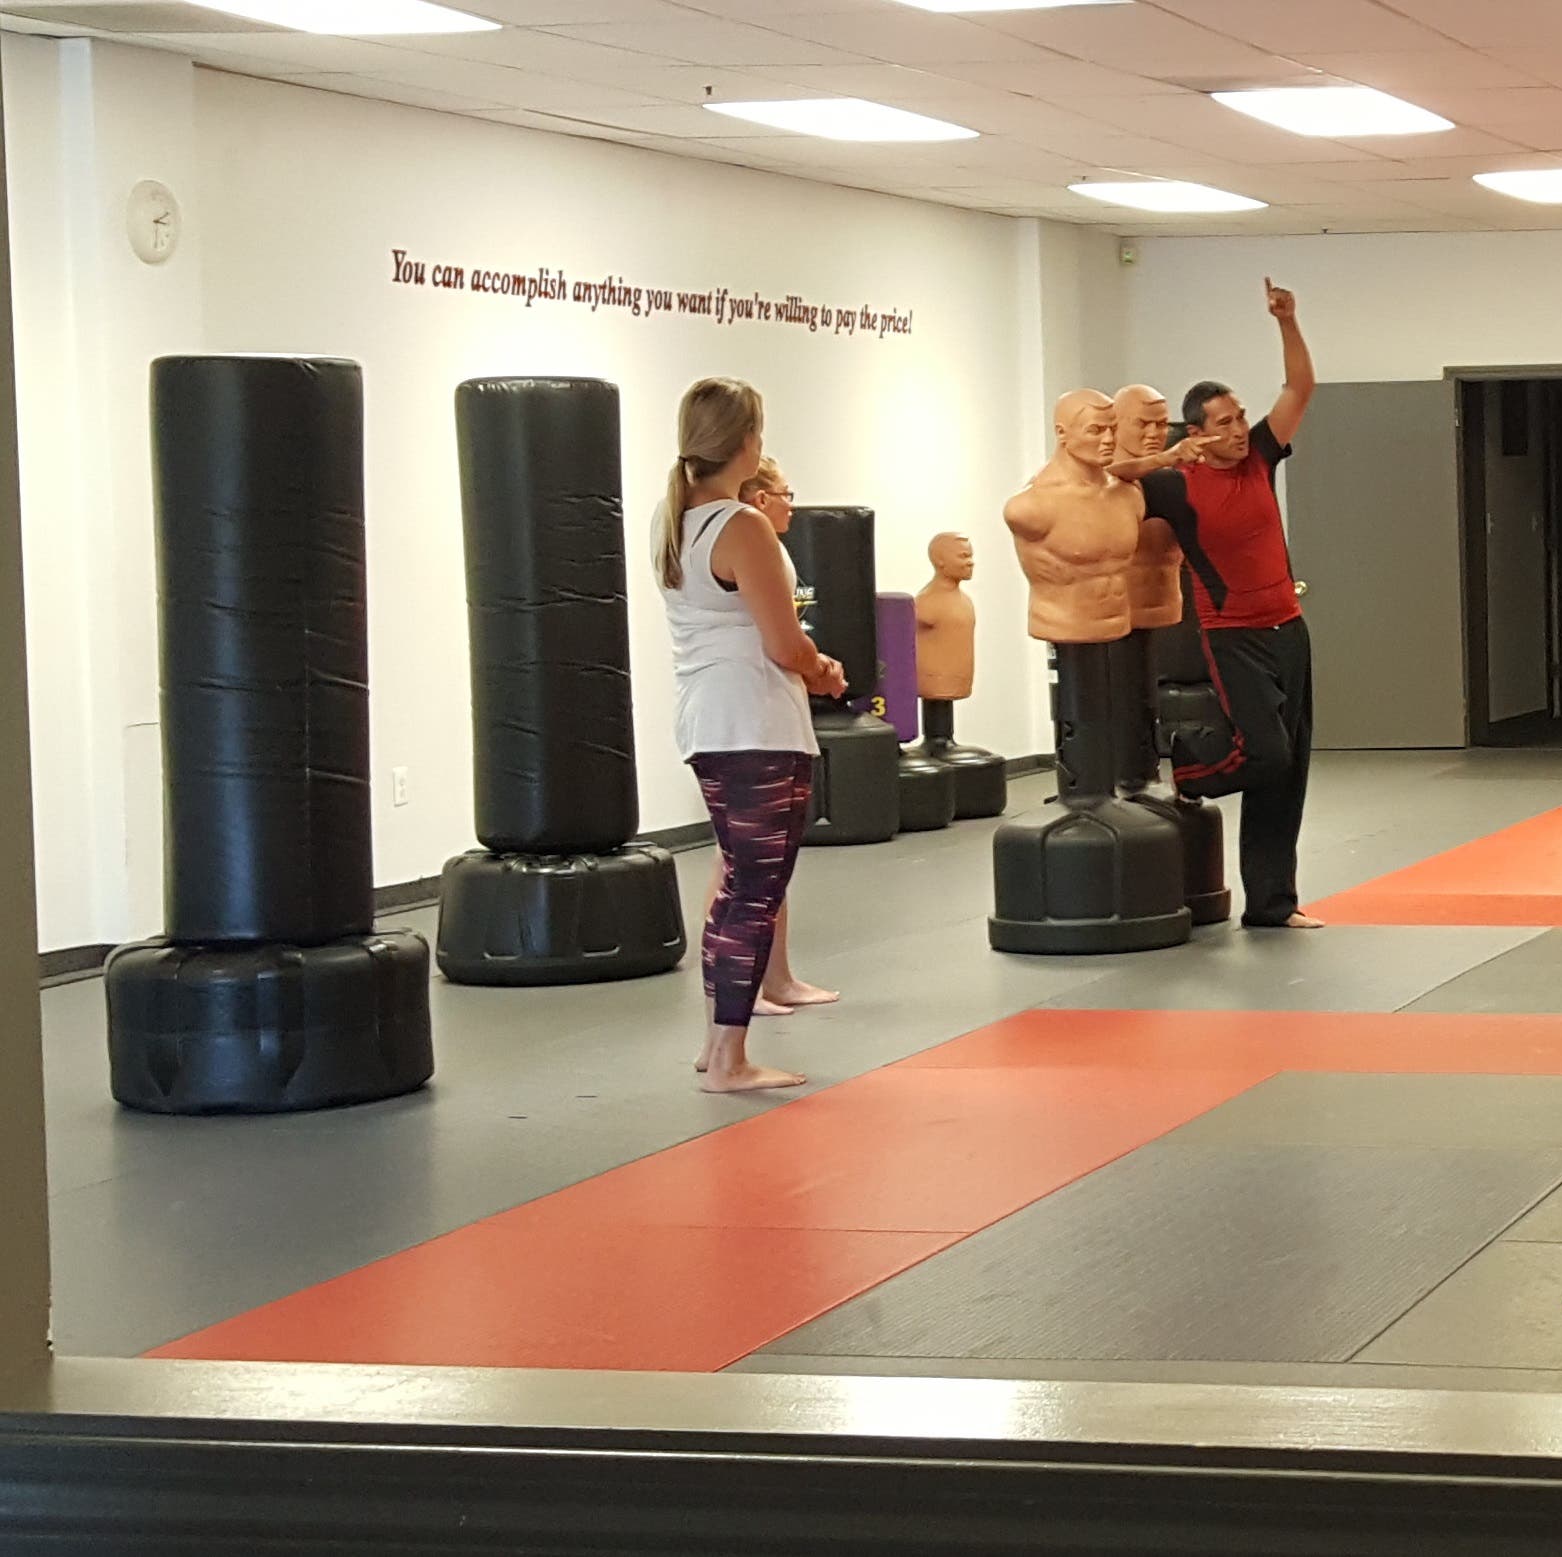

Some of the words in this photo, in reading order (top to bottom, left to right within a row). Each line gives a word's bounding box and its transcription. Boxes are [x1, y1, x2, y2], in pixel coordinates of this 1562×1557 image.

[391, 249, 426, 285] You
[431, 264, 464, 289] can
[471, 267, 567, 307] accomplish
[572, 276, 642, 316] anything
[645, 288, 672, 317] you
[677, 290, 712, 315] want
[715, 288, 728, 324] if
[728, 292, 771, 325] you're
[775, 295, 817, 332] willing
[821, 304, 832, 327] to
[836, 308, 856, 335] pay
[860, 304, 877, 331] the
[880, 307, 912, 338] price!
[870, 695, 886, 717] 3
